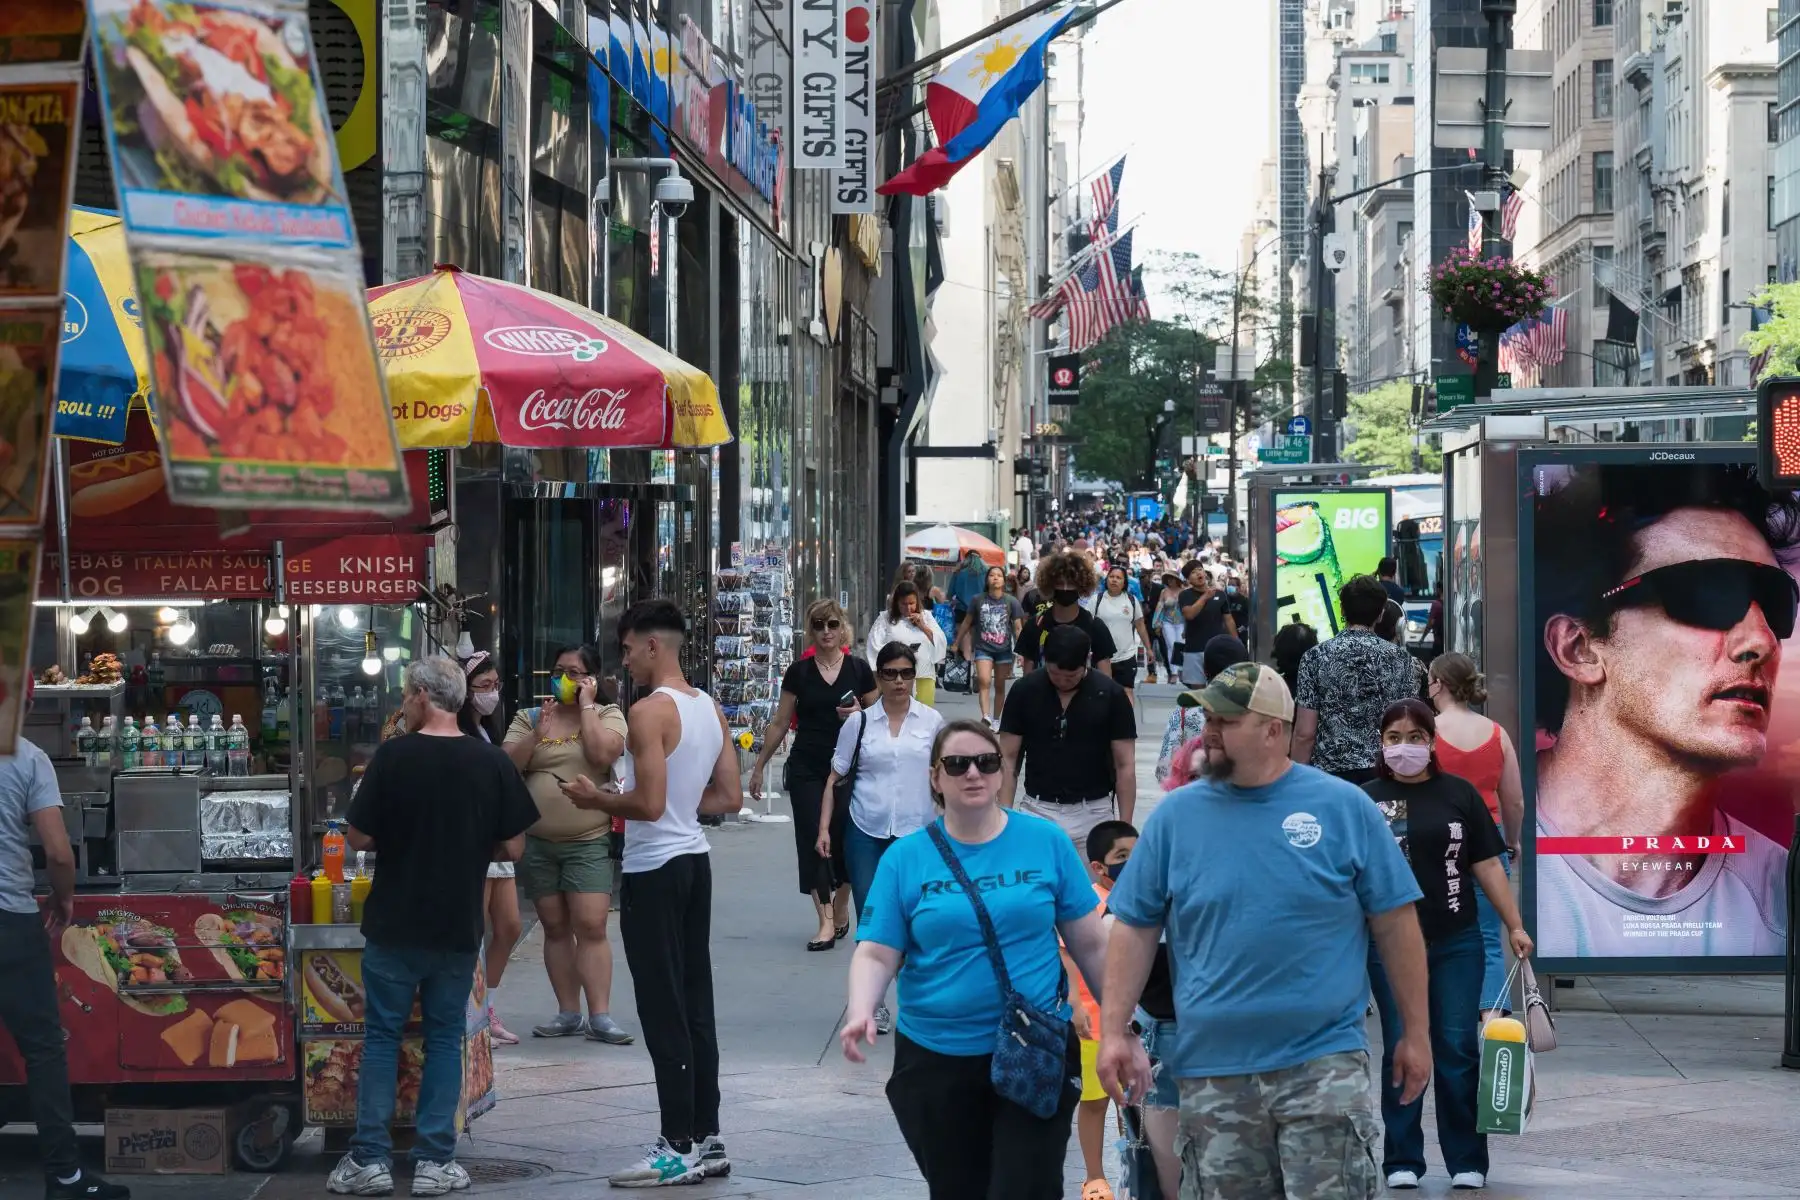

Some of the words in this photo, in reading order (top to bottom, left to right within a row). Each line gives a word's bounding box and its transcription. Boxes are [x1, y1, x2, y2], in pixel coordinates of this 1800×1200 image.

[845, 46, 869, 117] NY
[803, 72, 837, 158] GIFTS
[837, 128, 868, 204] GIFTS
[498, 330, 577, 351] NIKAS
[56, 400, 93, 417] ROLL
[388, 402, 408, 420] ot
[413, 400, 463, 422] Dogs
[1035, 423, 1059, 434] 590
[1292, 436, 1303, 447] 46
[1649, 452, 1696, 461] JCDecaux
[1334, 507, 1380, 530] BIG
[134, 556, 213, 571] ITALIAN
[222, 556, 312, 573] SAUSGE
[340, 556, 414, 574] KNISH
[160, 575, 261, 592] FALAFEL
[1622, 836, 1736, 849] PRADA
[1622, 862, 1693, 871] EYEWEAR
[920, 869, 1043, 900] ROGUE
[98, 909, 116, 918] MIX
[116, 909, 142, 922] GYRO
[221, 902, 258, 911] CHICKEN
[1496, 1053, 1509, 1107] Nintendo
[117, 1129, 177, 1156] Pretzel
